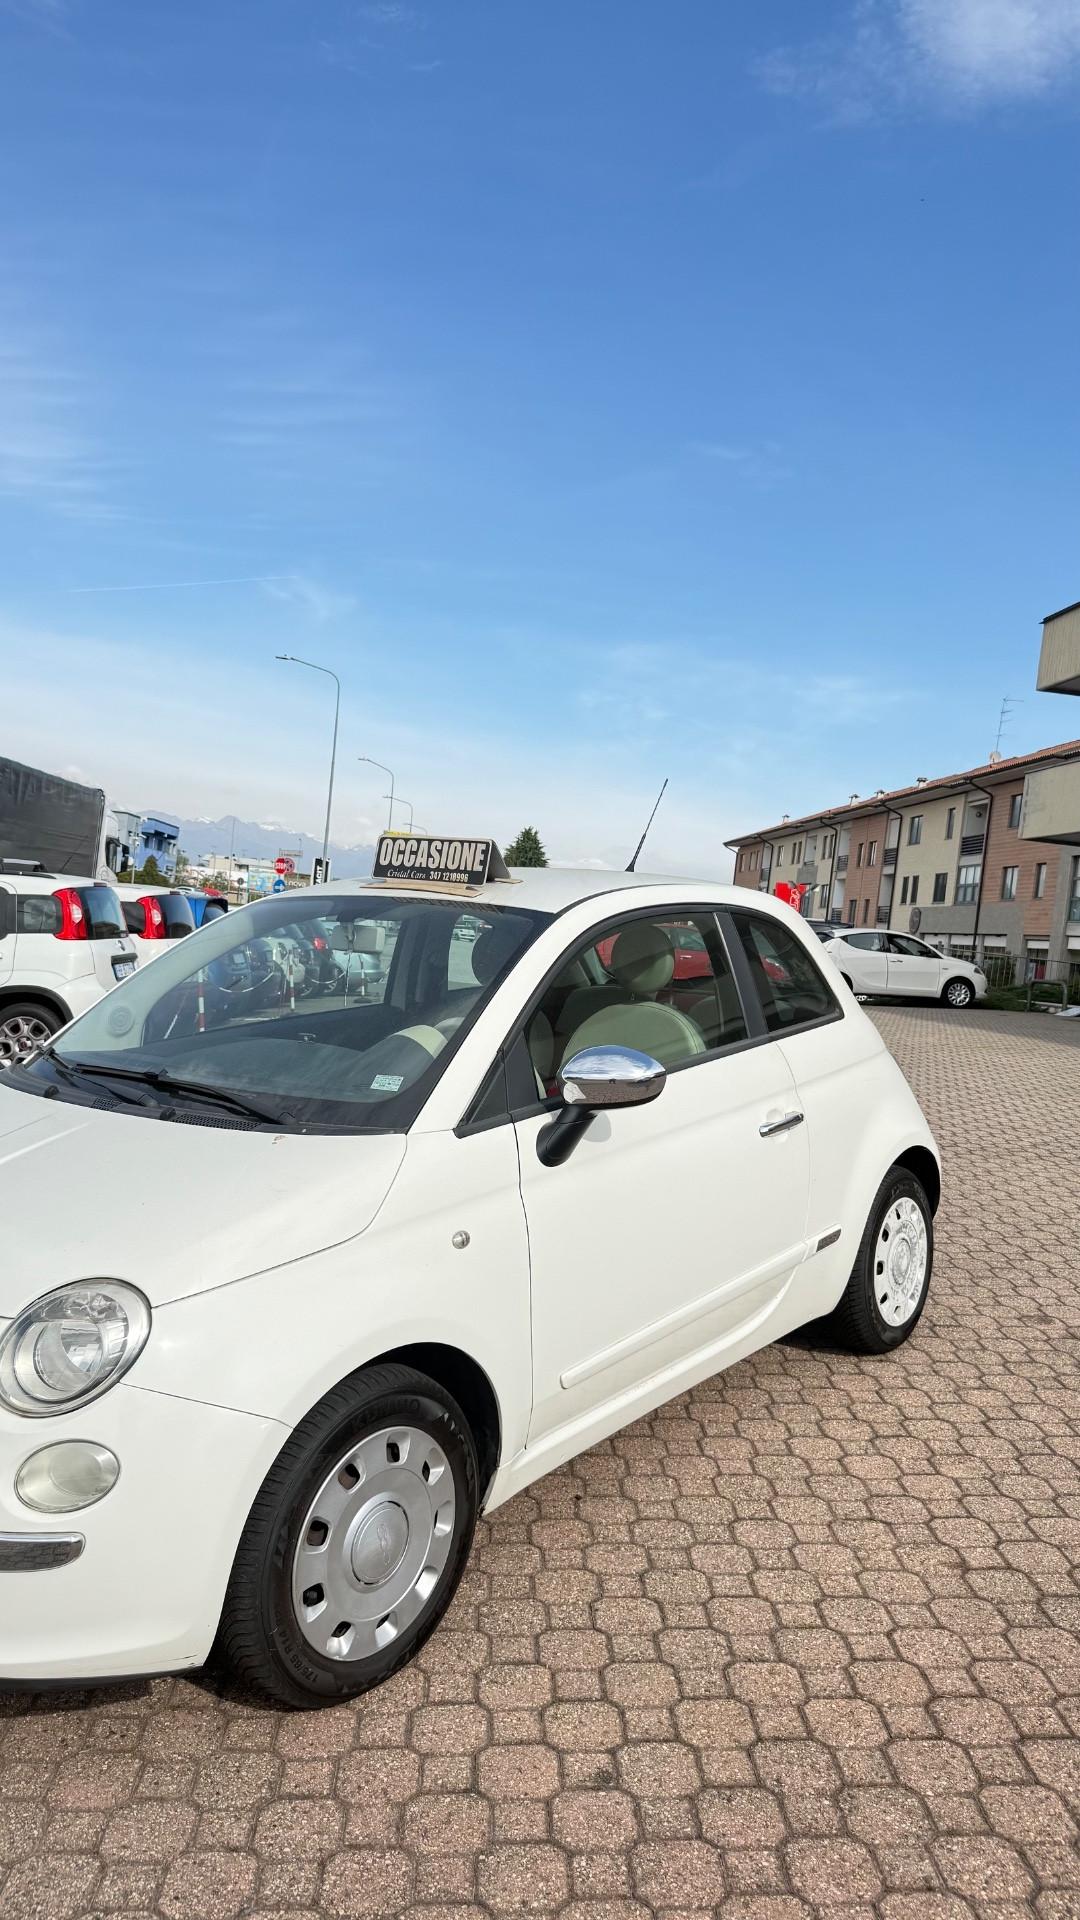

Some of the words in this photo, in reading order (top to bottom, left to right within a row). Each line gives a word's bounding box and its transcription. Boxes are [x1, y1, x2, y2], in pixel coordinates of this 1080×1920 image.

[379, 838, 487, 872] OCCASIONE
[411, 870, 426, 880] Cars
[429, 871, 441, 881] 347
